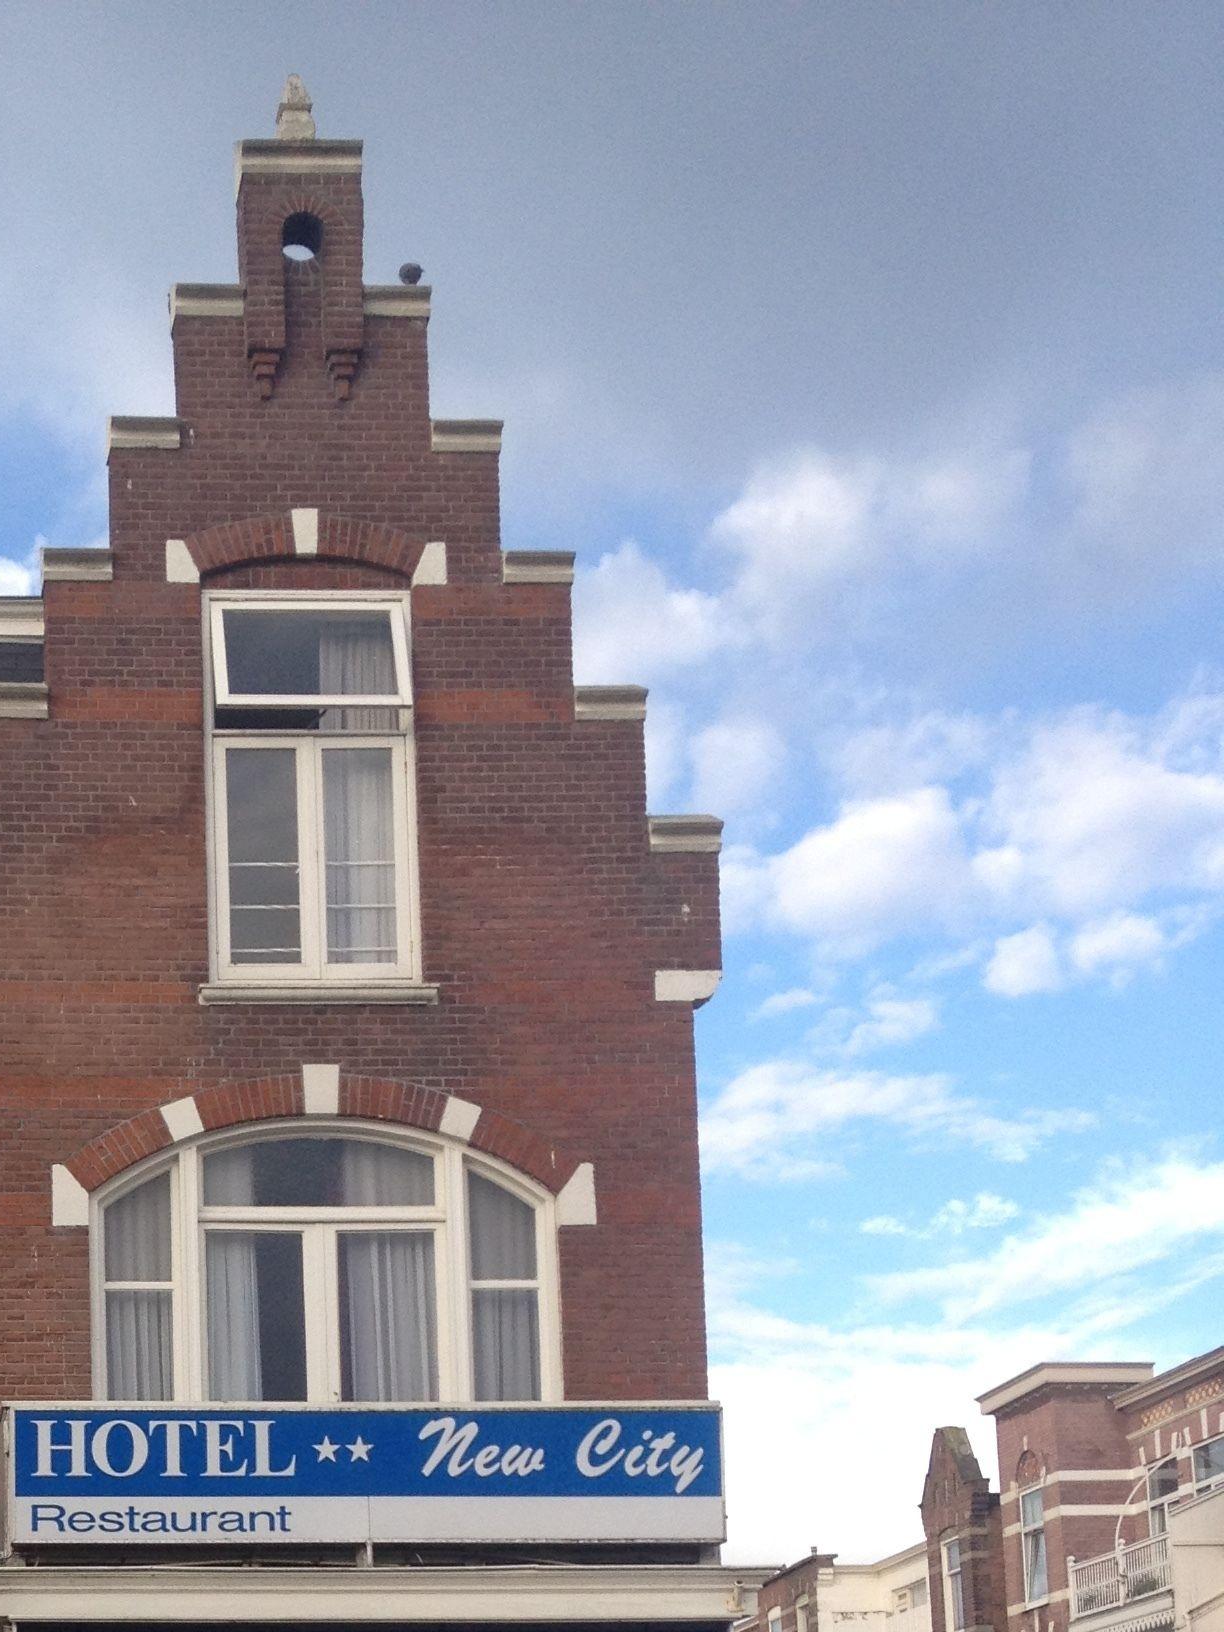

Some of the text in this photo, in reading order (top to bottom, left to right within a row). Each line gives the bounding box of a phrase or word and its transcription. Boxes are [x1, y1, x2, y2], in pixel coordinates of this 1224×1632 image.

[30, 1416, 706, 1494] HOTEL New City
[30, 1504, 292, 1534] Restaurant
